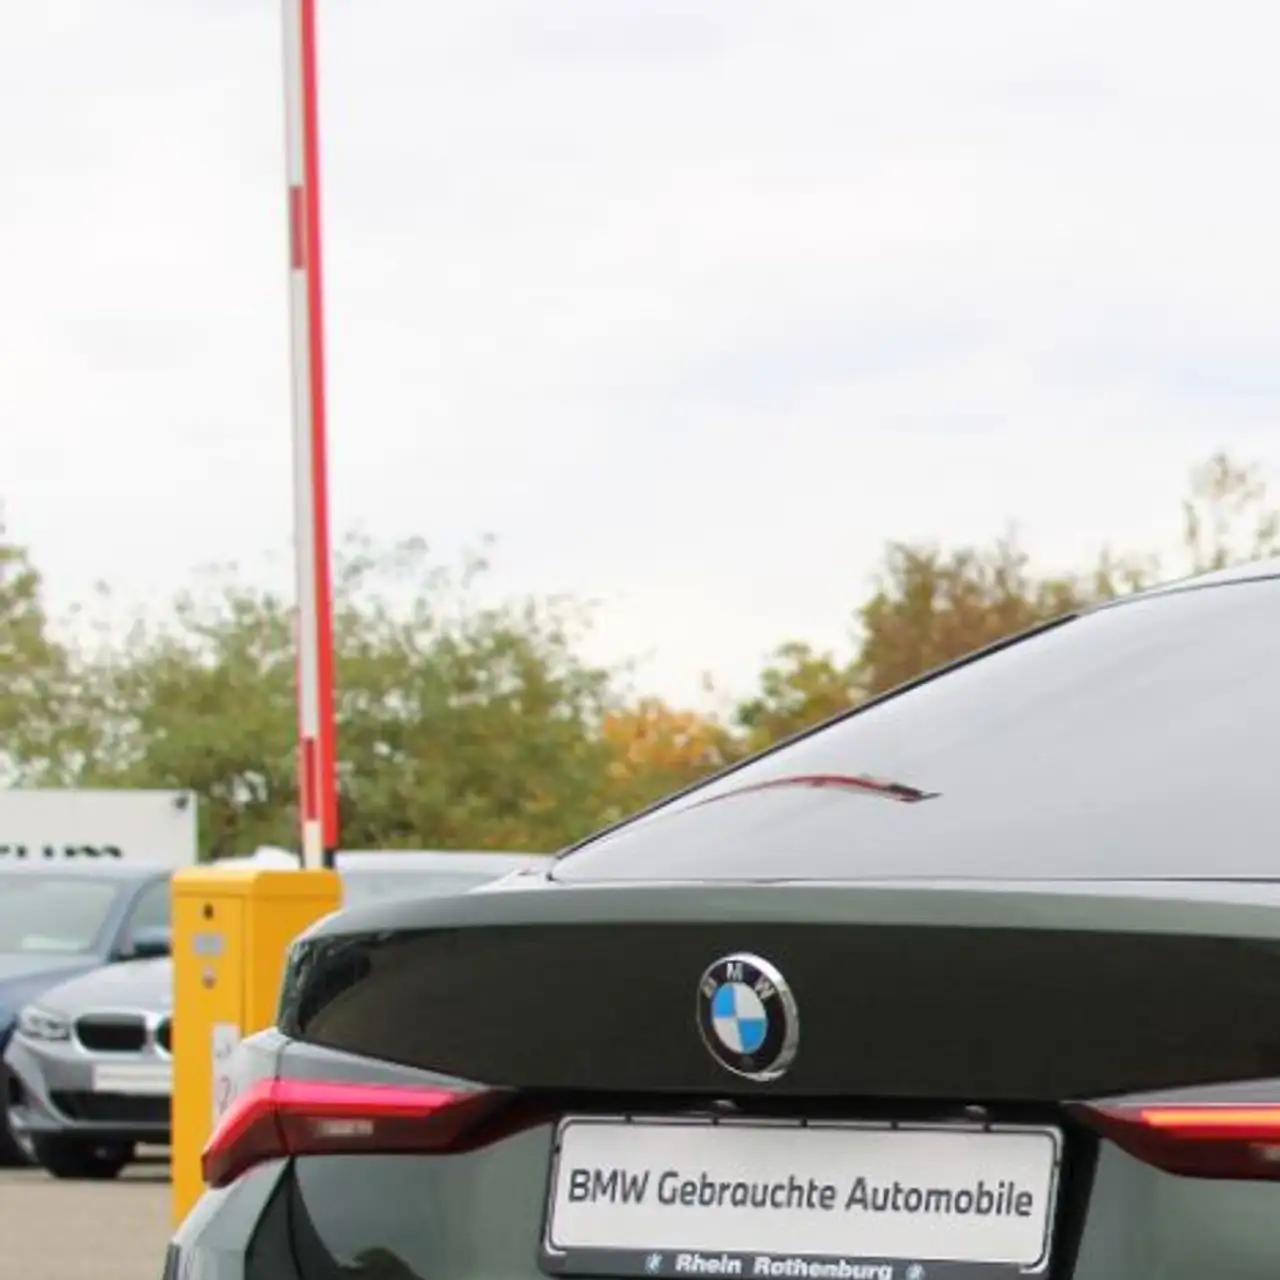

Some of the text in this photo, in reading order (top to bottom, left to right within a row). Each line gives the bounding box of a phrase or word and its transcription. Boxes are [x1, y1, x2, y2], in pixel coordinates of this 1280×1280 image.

[701, 962, 777, 1001] BMW
[568, 1168, 1033, 1217] BMW Gebrauchte Automobile
[675, 1253, 742, 1275] Rhein
